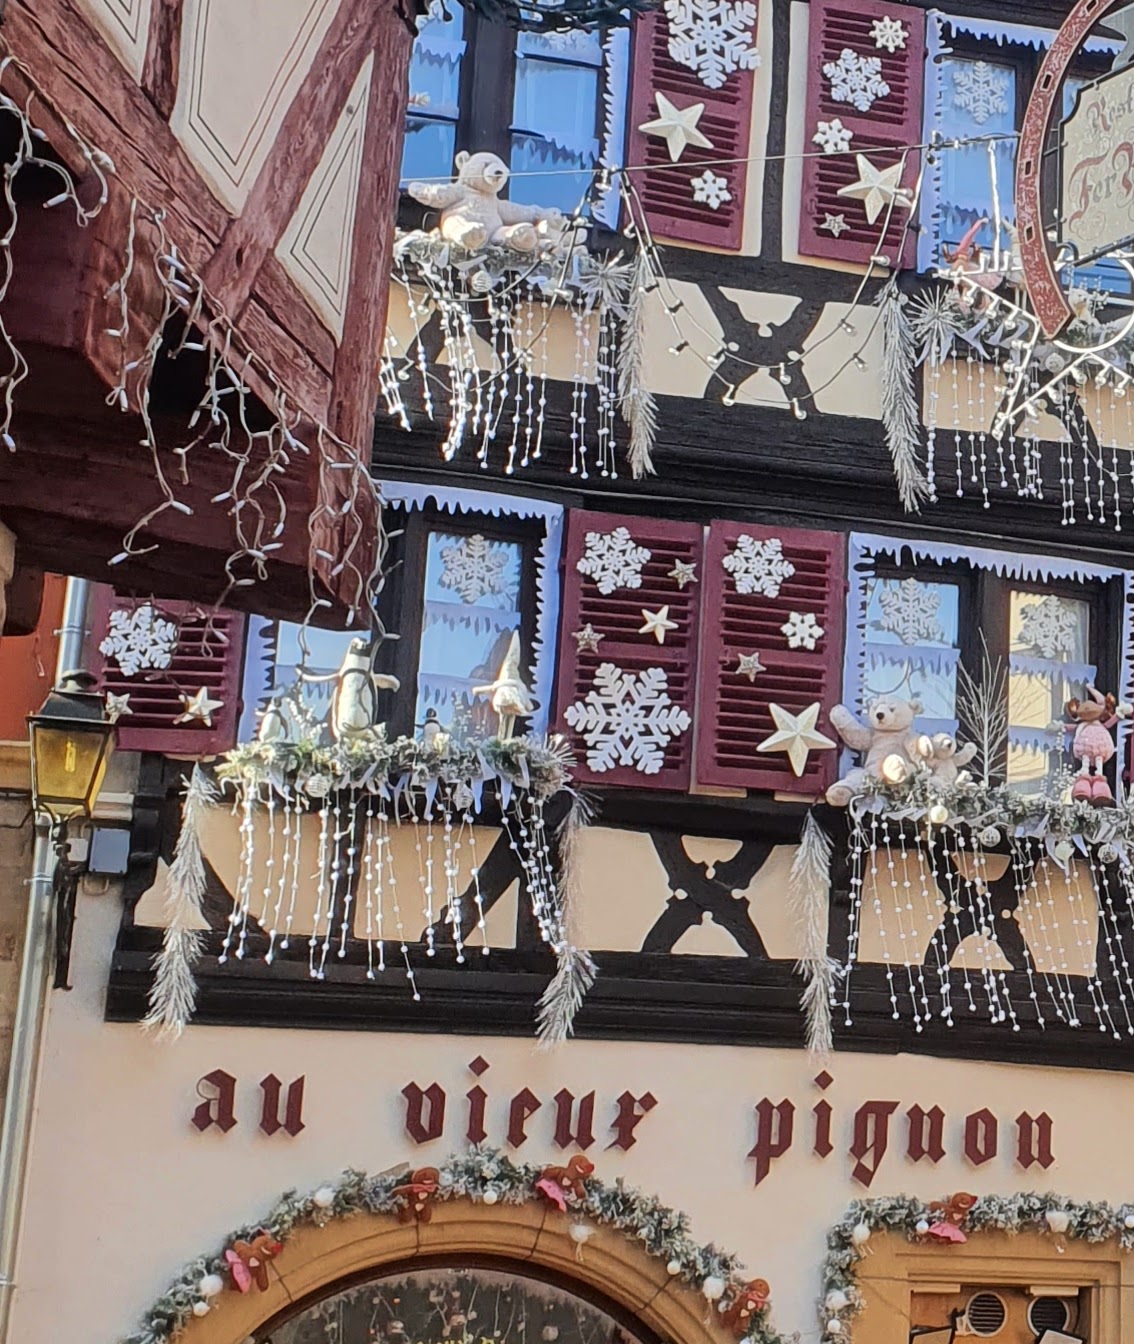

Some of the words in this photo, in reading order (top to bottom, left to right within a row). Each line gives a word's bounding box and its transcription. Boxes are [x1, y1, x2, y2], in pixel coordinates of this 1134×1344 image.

[1069, 151, 1117, 225] Fer
[191, 1068, 306, 1137] au
[401, 1054, 659, 1151] vieux
[748, 1071, 1056, 1188] pignon
